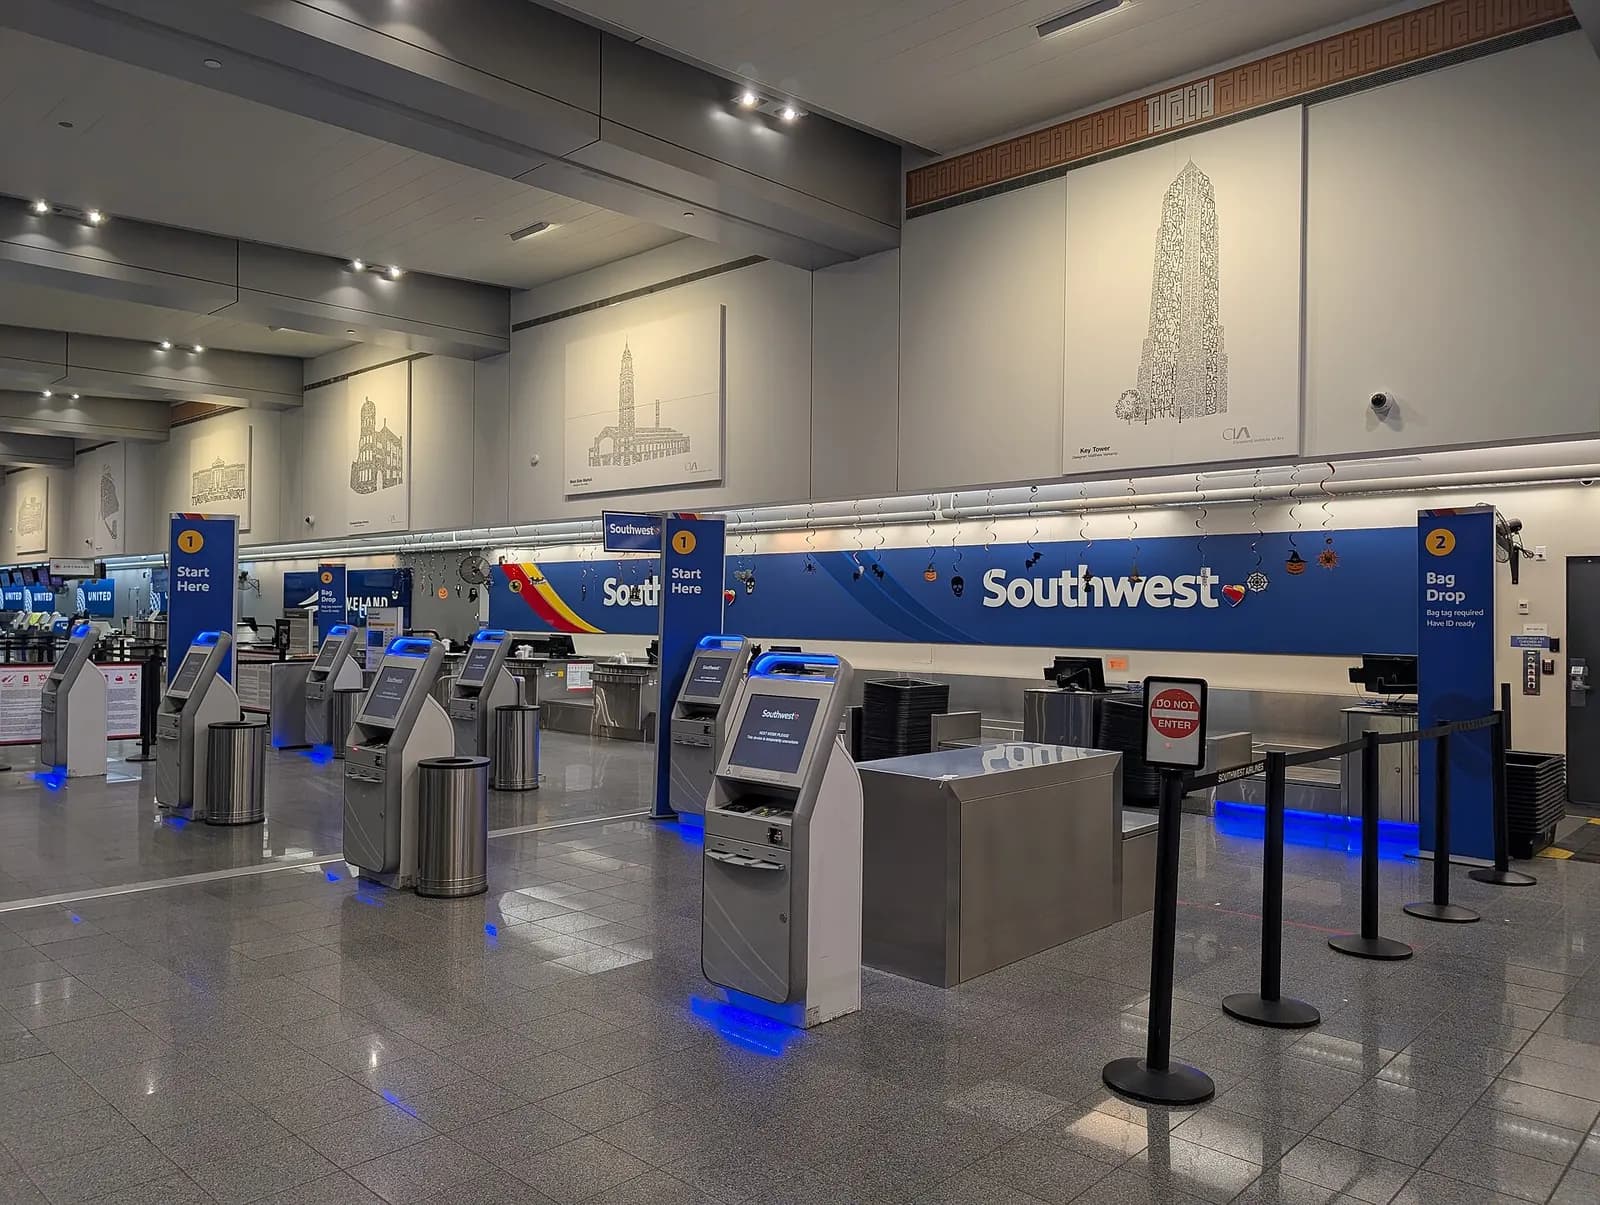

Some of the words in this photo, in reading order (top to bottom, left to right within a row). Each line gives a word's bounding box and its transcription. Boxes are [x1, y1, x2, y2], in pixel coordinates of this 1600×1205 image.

[610, 523, 654, 535] Southwest
[187, 536, 194, 547] 1
[680, 537, 687, 548] 1
[1435, 536, 1446, 549] 2
[177, 566, 210, 578] Start
[671, 567, 702, 579] Start
[1426, 572, 1455, 587] Bag
[177, 580, 210, 592] Here
[671, 583, 702, 594] Here
[983, 565, 1219, 608] Southwest
[5, 592, 22, 600] UNITED
[34, 592, 53, 601] UNITED
[88, 592, 112, 601] UNITED
[1426, 589, 1466, 605] Drop
[1426, 609, 1440, 617] Bag
[1454, 609, 1484, 617] required
[1455, 620, 1476, 628] ready
[1156, 699, 1171, 709] DO
[1173, 700, 1195, 710] NOT
[762, 709, 794, 720] Southwest
[1158, 719, 1192, 730] ENTER
[1218, 766, 1246, 783] SOUTHWEST
[1245, 762, 1265, 776] AIRLINES
